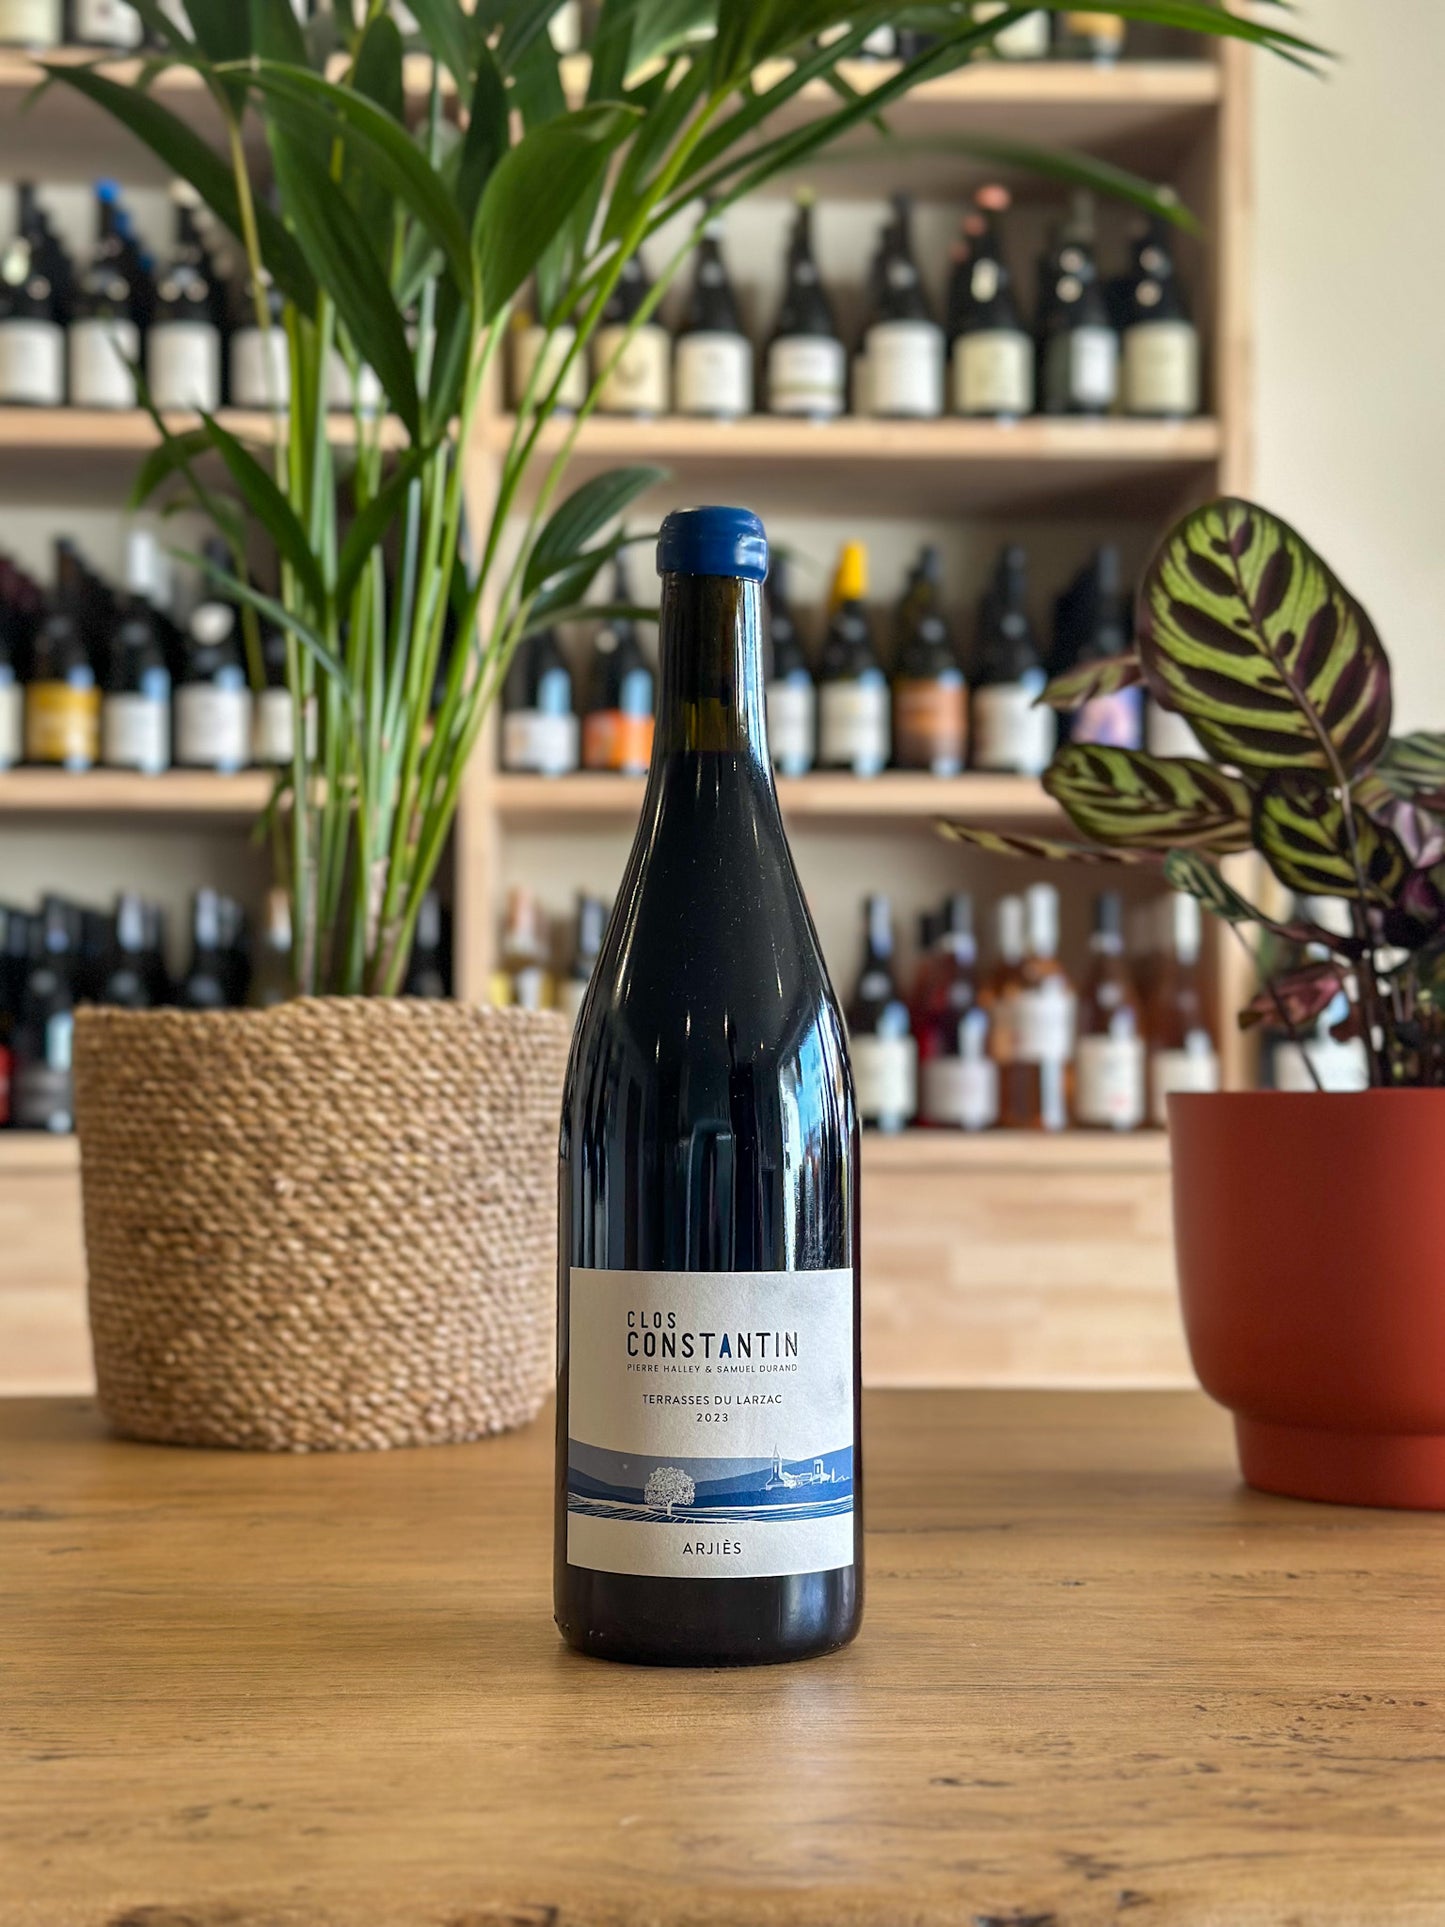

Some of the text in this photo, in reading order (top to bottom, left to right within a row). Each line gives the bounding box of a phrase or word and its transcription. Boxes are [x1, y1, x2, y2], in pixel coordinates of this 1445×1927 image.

[627, 1310, 677, 1329] CLOS
[627, 1331, 798, 1359] CONSTANTIN
[626, 1363, 798, 1374] PIERRE HALLEY & SAMUEL DURAND
[642, 1393, 783, 1406] TERRASSES DU LARZAC
[696, 1412, 729, 1423] 2023
[682, 1538, 742, 1556] ARJIÈS
